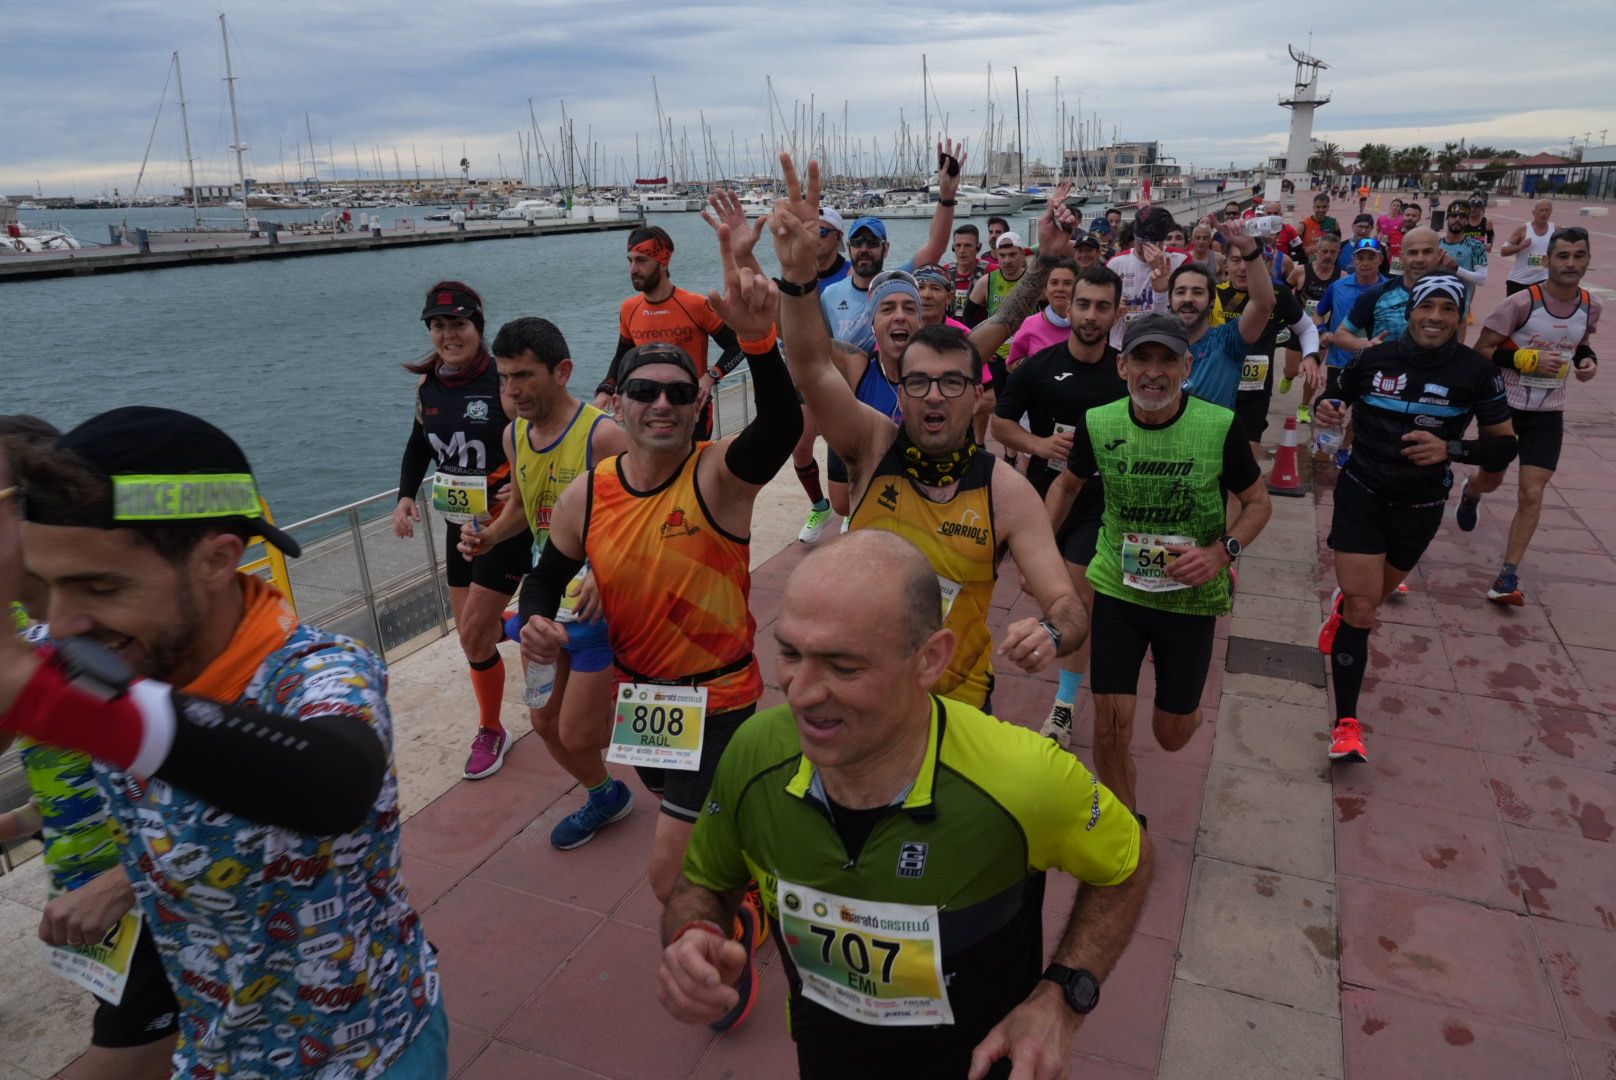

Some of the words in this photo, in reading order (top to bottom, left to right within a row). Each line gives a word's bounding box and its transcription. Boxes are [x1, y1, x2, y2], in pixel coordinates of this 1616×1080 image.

[1131, 458, 1194, 476] MARATÓ
[447, 489, 469, 507] 53
[941, 521, 989, 541] CORRIOLS
[632, 705, 684, 736] 808
[839, 908, 879, 929] marató
[880, 918, 930, 932] CASTELLÓ
[809, 924, 901, 984] 707
[847, 971, 878, 997] EMI
